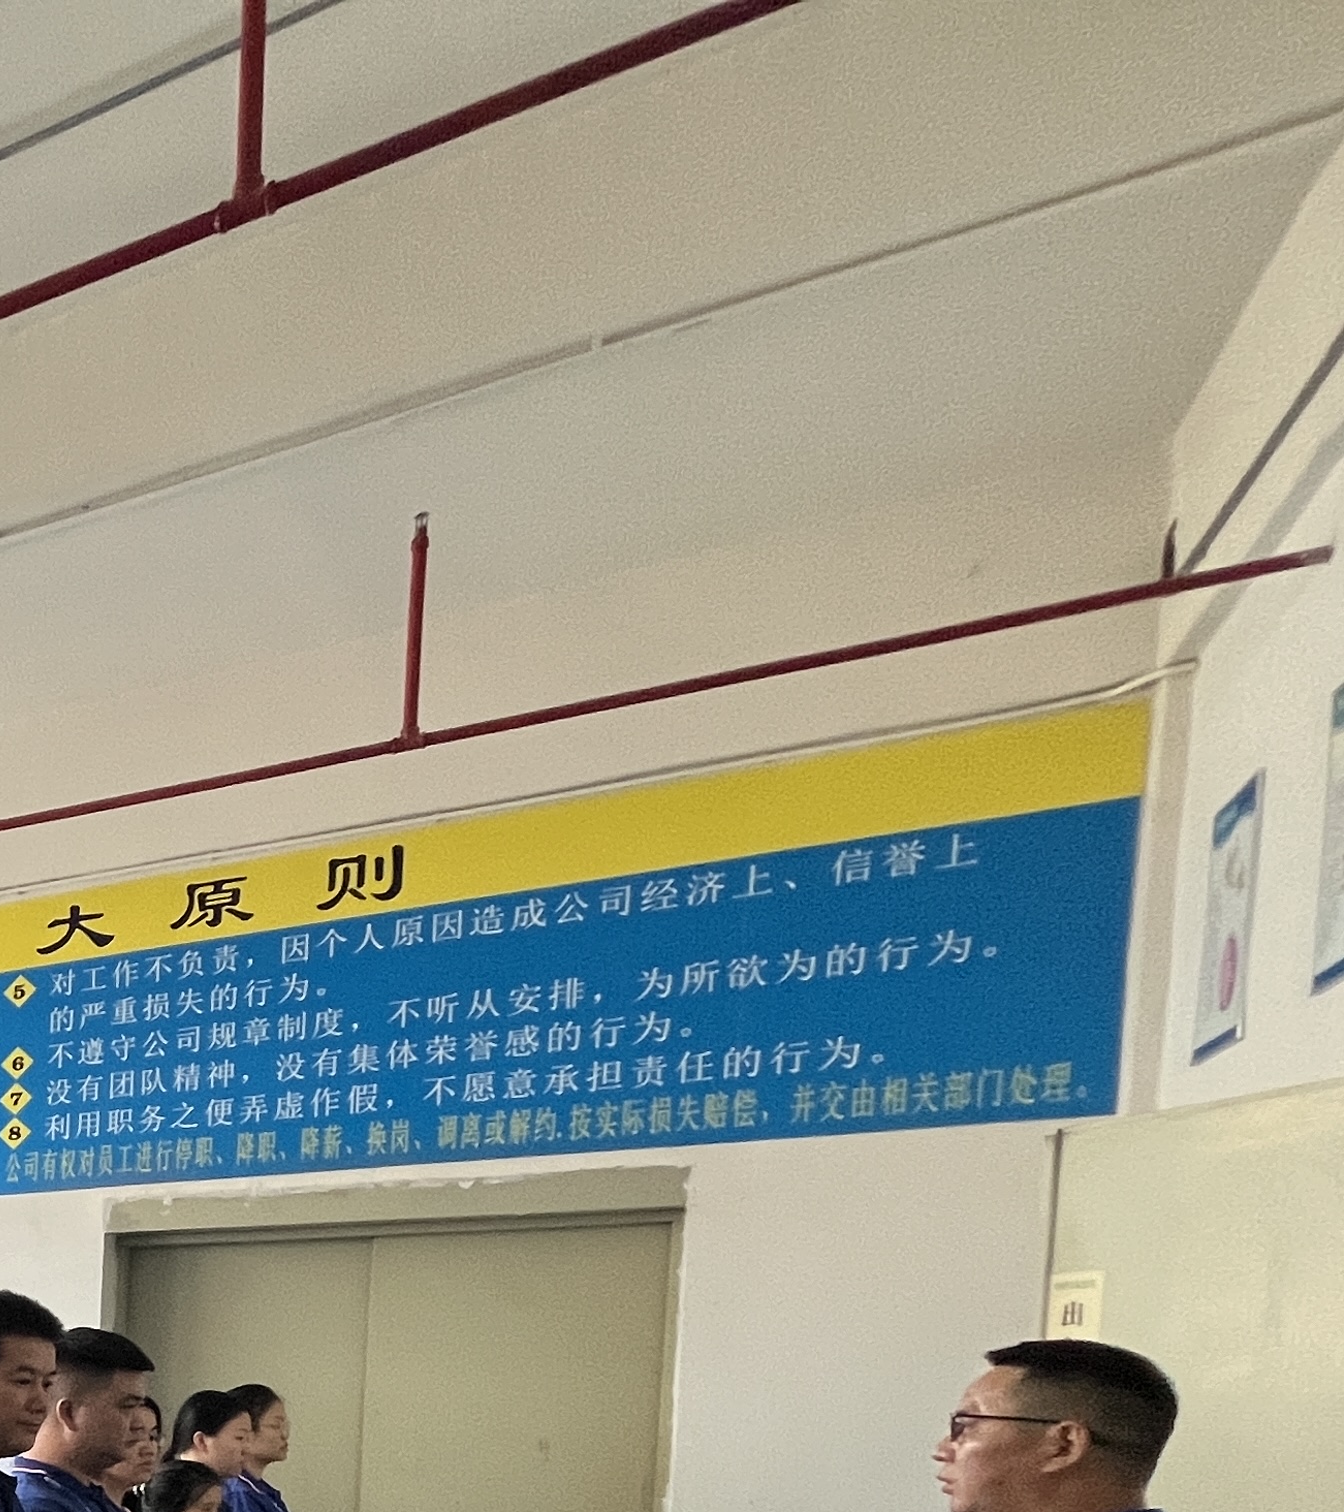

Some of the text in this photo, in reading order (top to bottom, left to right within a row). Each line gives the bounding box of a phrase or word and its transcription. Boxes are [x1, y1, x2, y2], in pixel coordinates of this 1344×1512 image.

[13, 984, 26, 1000] 5
[49, 972, 326, 1034] 的严重损失的行为。
[12, 1056, 24, 1071] 6
[10, 1091, 23, 1107] 7
[8, 1126, 22, 1141] 8
